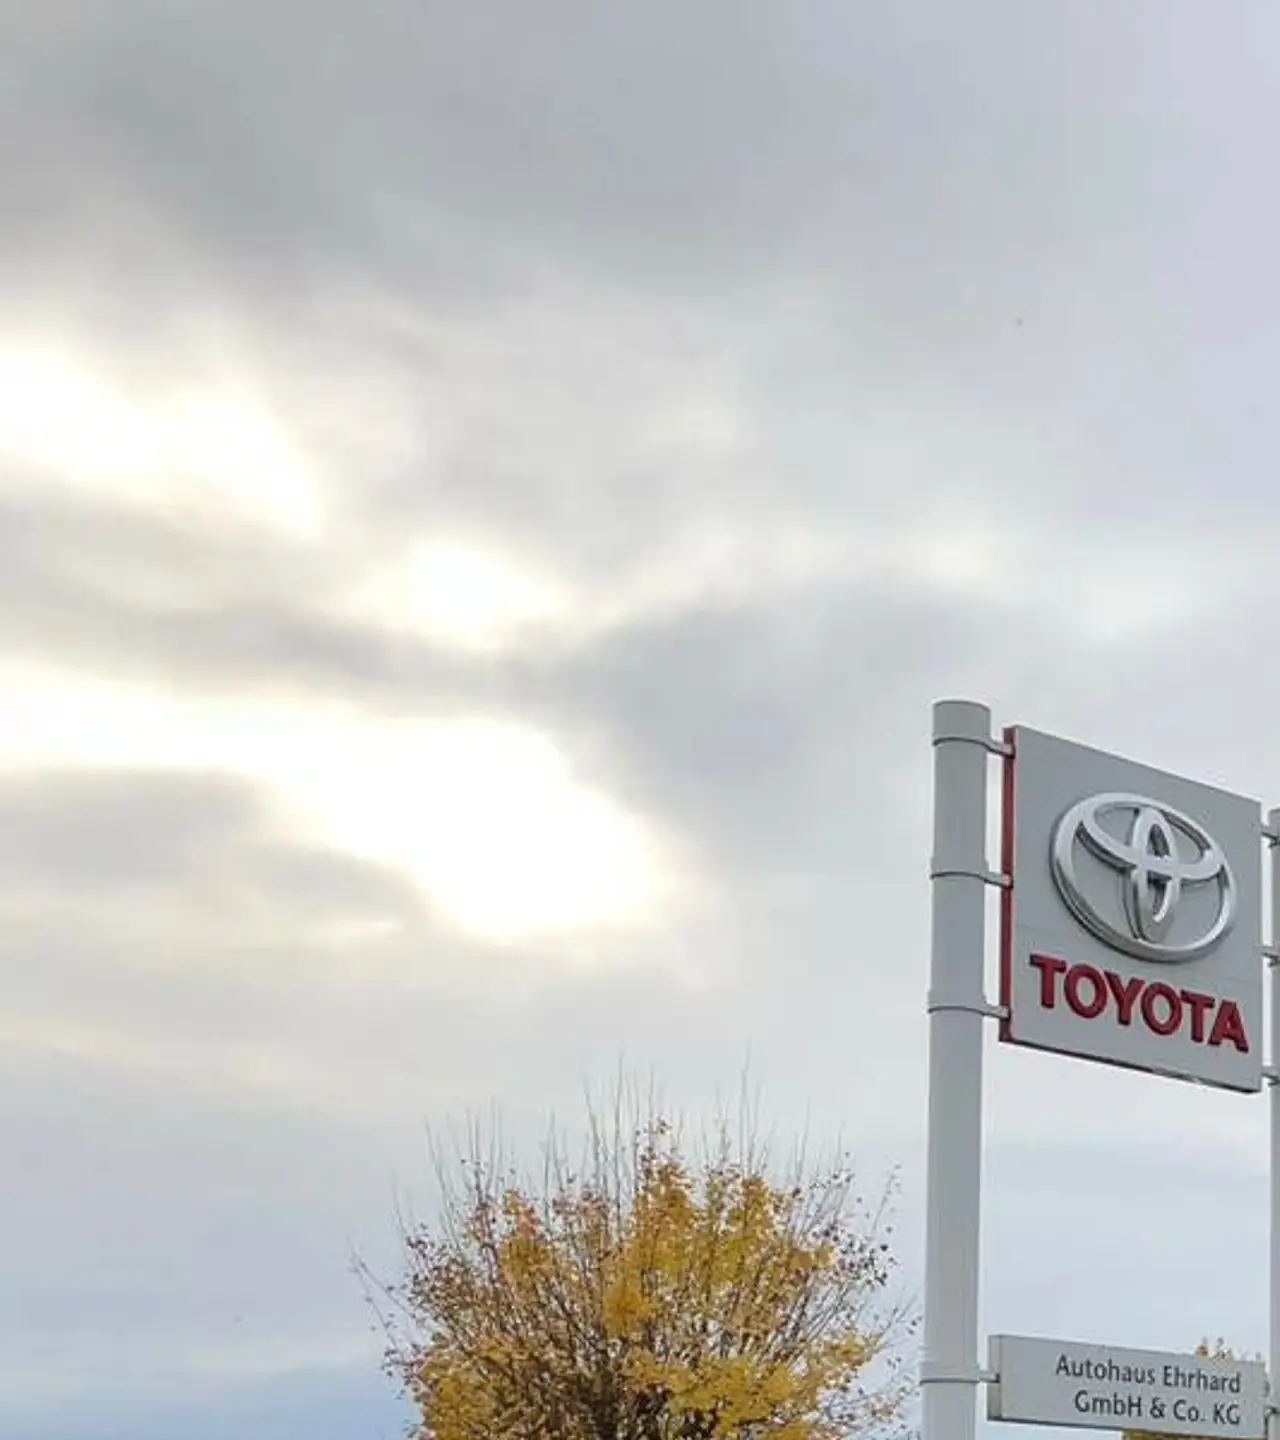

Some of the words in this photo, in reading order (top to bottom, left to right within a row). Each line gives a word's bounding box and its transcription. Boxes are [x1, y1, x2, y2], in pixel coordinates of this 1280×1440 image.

[1030, 952, 1249, 1053] TOYOTA
[1055, 1354, 1155, 1384] Autohaus
[1163, 1365, 1241, 1394] Ehrhard
[1074, 1389, 1141, 1418] GmbH
[1150, 1397, 1165, 1419] &
[1173, 1400, 1206, 1422] Co.
[1213, 1403, 1241, 1425] KG
